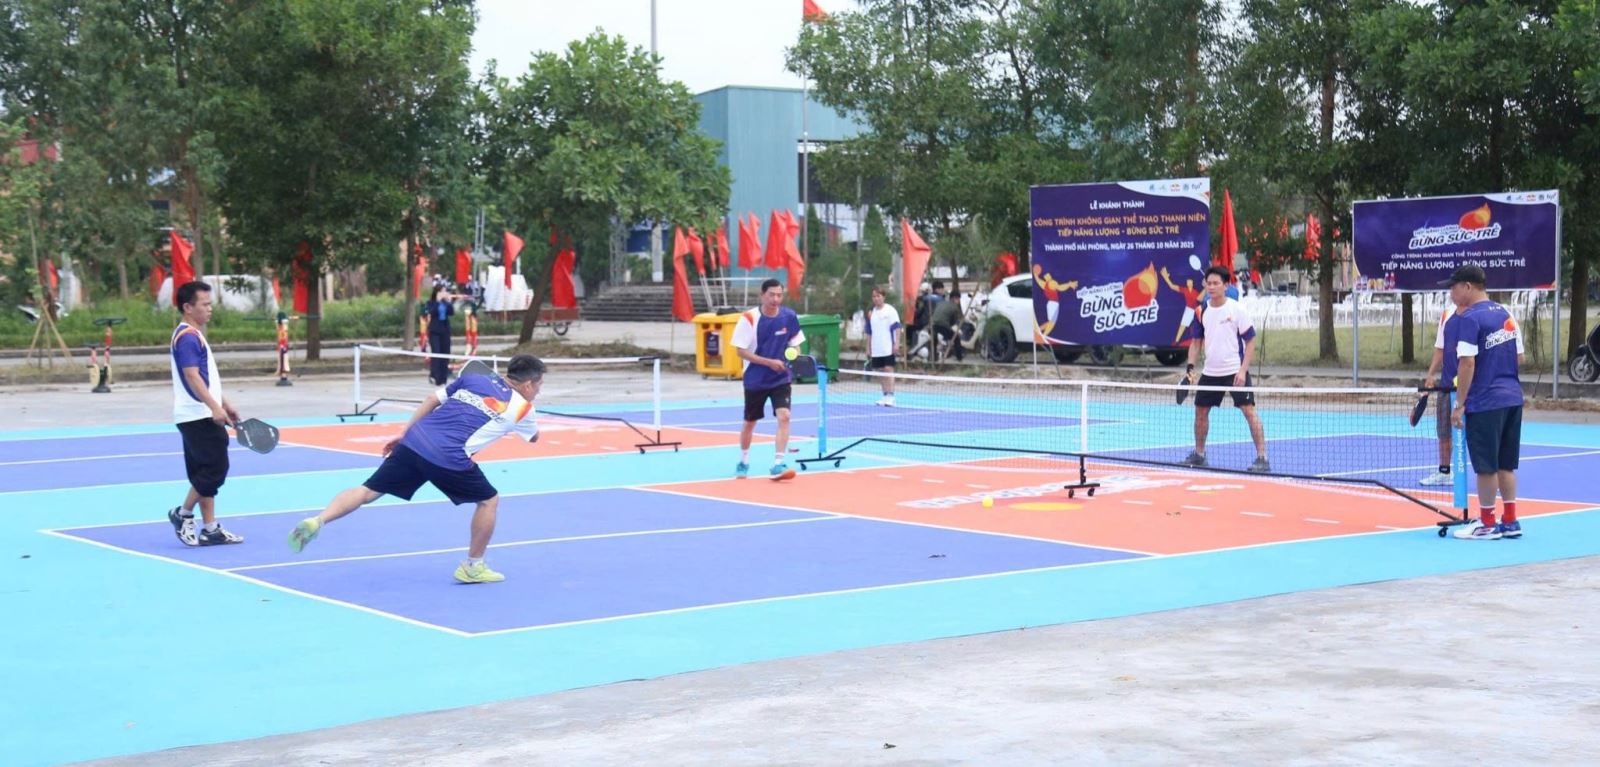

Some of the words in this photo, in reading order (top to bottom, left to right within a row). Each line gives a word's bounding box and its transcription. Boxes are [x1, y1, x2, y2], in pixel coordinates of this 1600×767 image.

[1033, 217, 1053, 227] CÔNG
[1076, 216, 1102, 226] KHÔNG
[1103, 216, 1121, 225] GIAN
[1139, 215, 1159, 224] THAO
[1160, 214, 1186, 223] THANH
[1187, 212, 1206, 222] NIÊN
[1135, 240, 1156, 249] THÁNG
[1156, 241, 1164, 249] 10
[1410, 235, 1445, 249] BỪNG
[1447, 229, 1473, 243] SỨC
[1474, 224, 1500, 239] TRẺ
[1381, 260, 1398, 271] TIẾP
[1399, 260, 1424, 270] NĂNG
[1425, 260, 1455, 270] LƯỢNG
[1489, 257, 1507, 268] SỨC
[1509, 256, 1526, 267] TRẺ
[1081, 294, 1123, 315] BỪNG
[1095, 309, 1126, 331] SỨC
[1130, 301, 1157, 324] TRẺ
